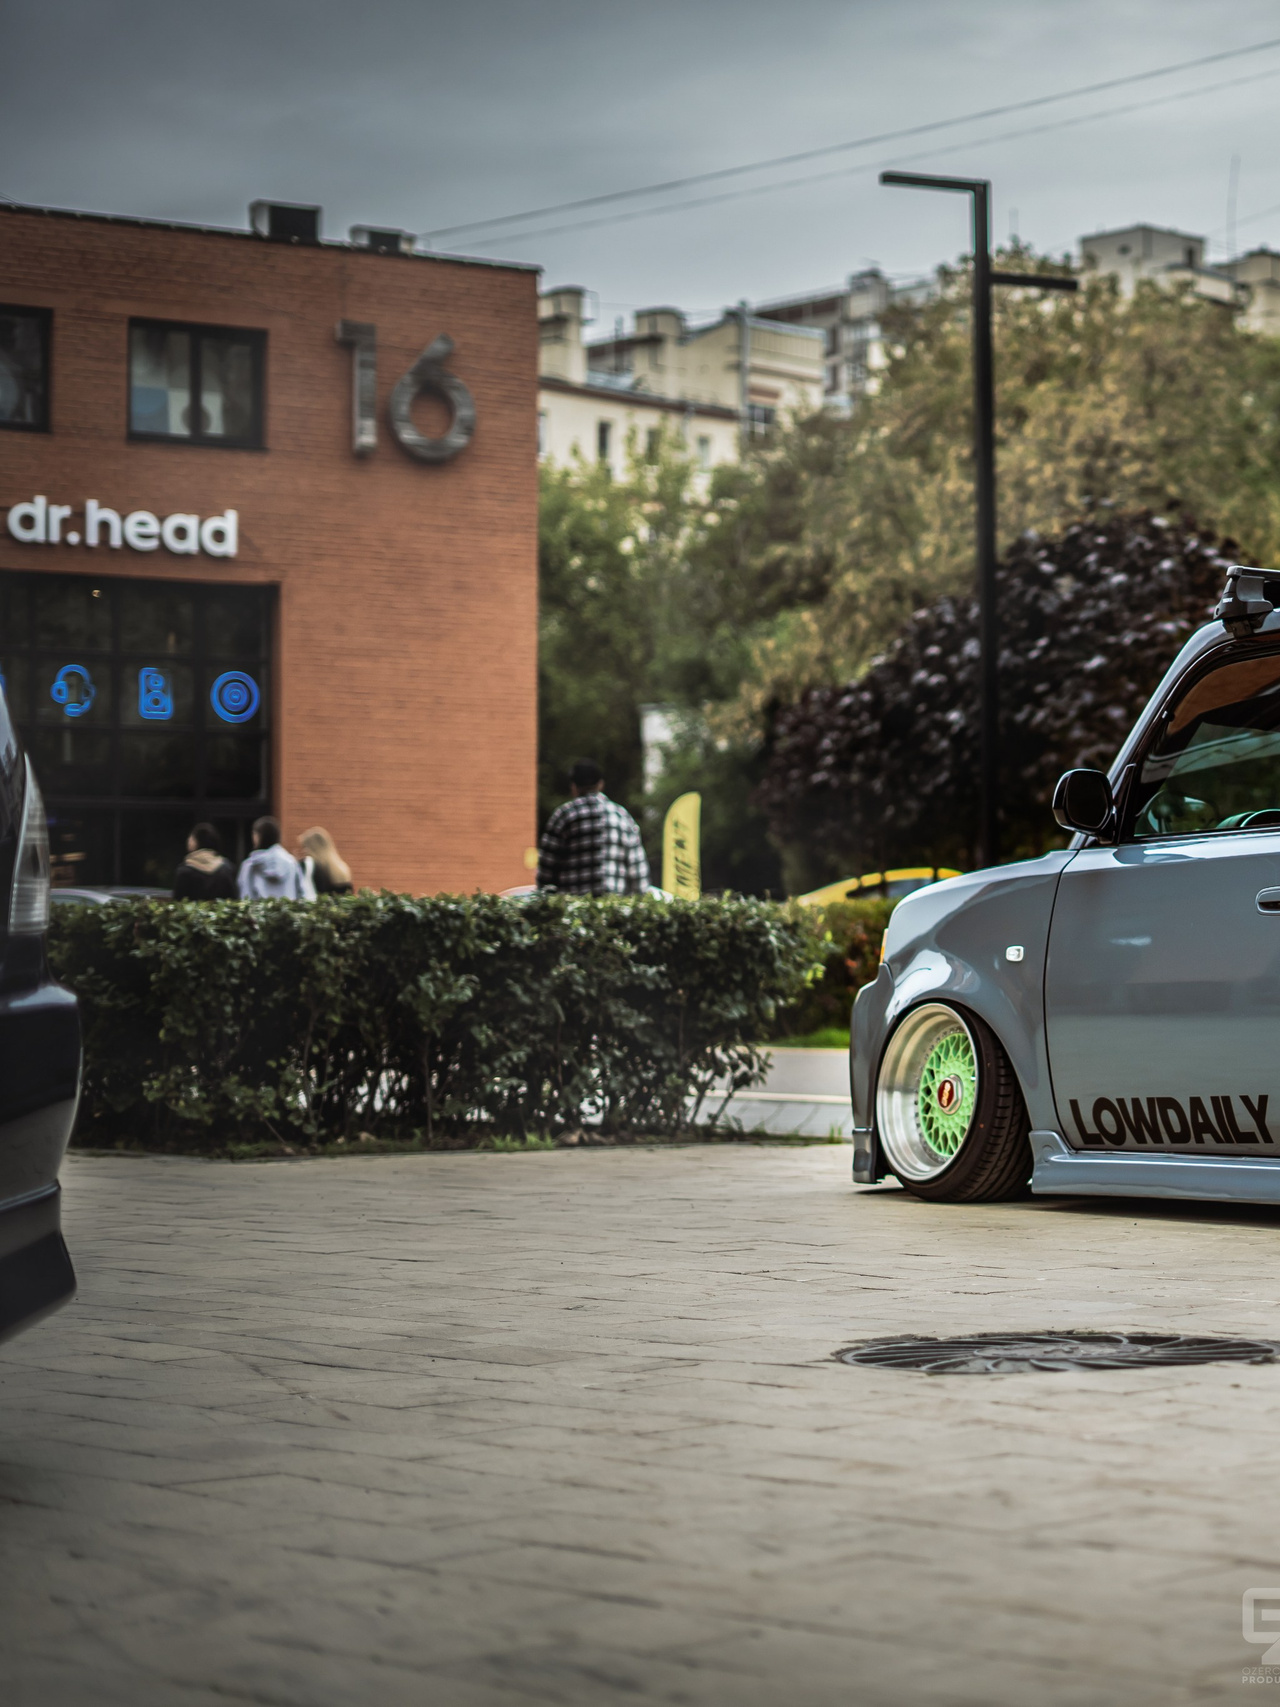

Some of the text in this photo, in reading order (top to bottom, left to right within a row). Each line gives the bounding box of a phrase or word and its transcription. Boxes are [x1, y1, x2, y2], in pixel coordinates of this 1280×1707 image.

[335, 319, 476, 461] 16
[7, 495, 239, 558] dr.head
[1069, 1094, 1274, 1146] LOWDAILY
